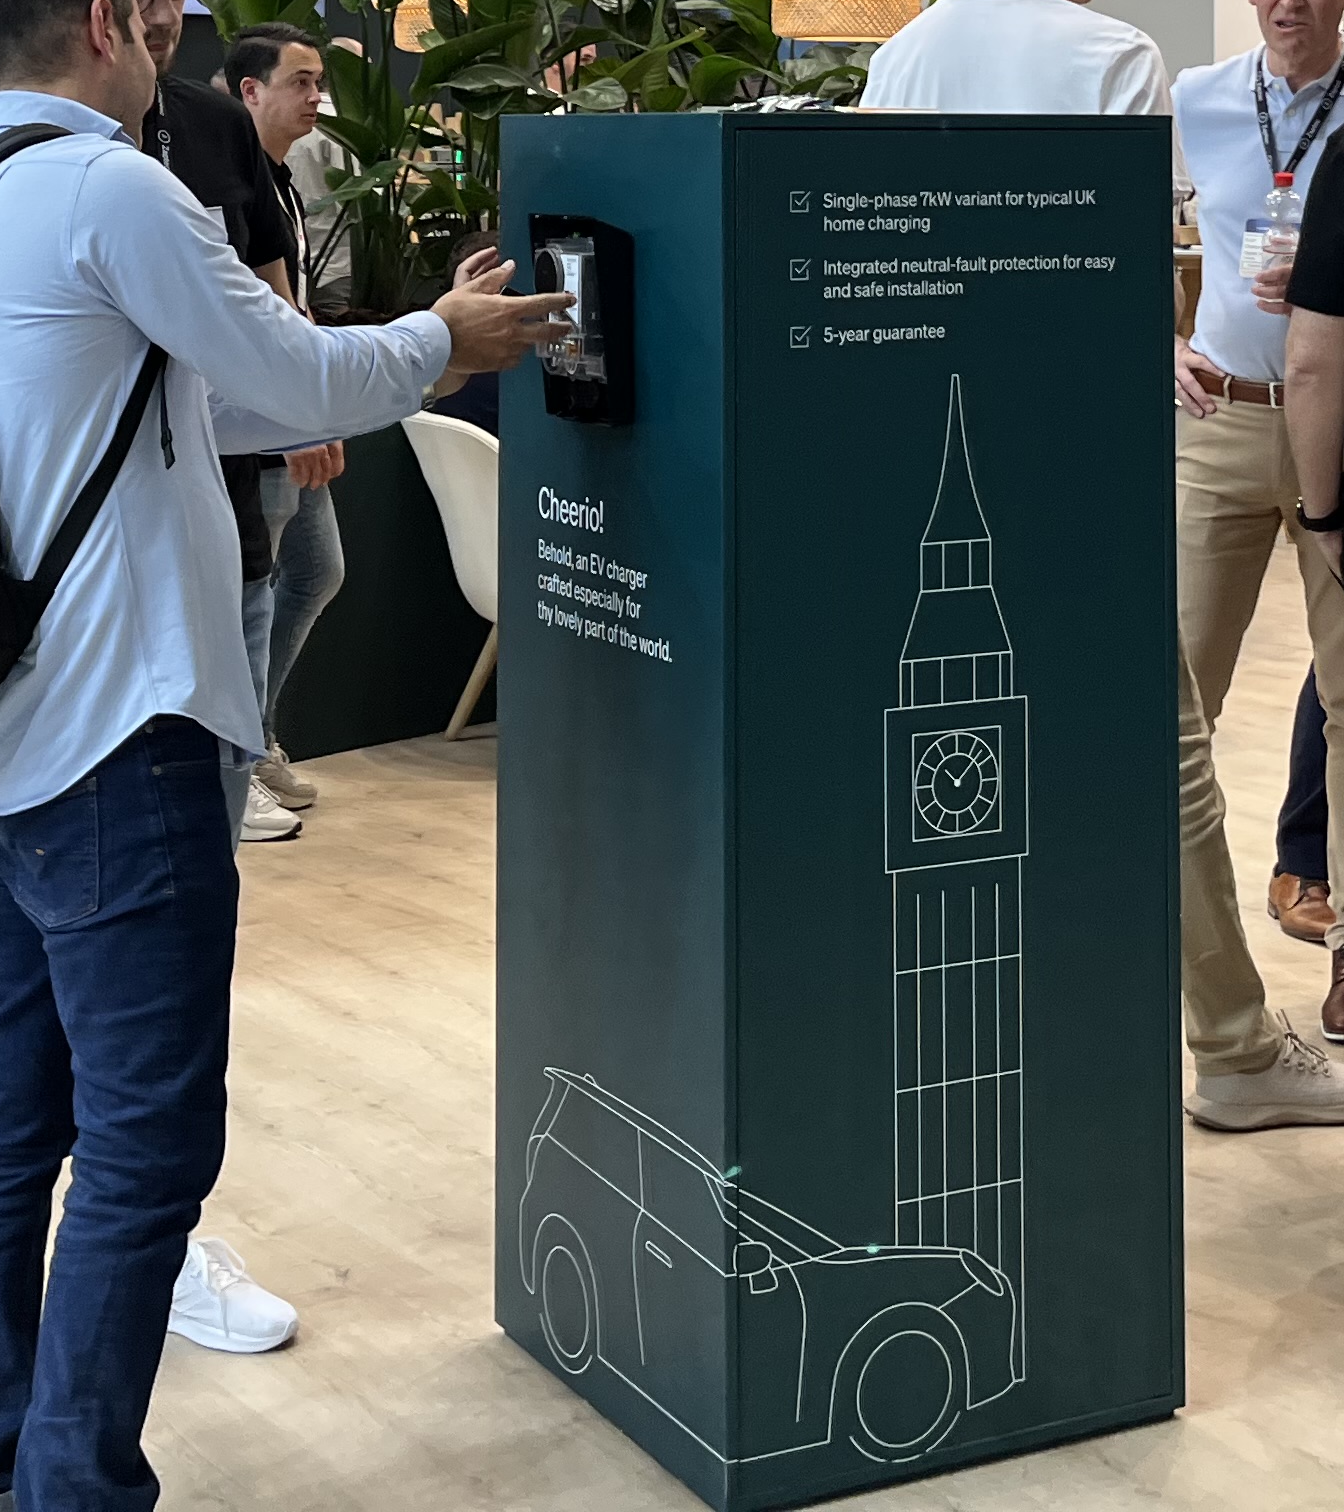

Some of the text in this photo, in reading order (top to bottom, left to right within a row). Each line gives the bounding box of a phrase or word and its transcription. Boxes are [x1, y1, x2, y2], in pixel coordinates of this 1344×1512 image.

[823, 189, 1096, 211] Single-phase 7kW variant for typical UK
[823, 215, 931, 234] home charging
[823, 254, 1116, 278] Integrated neutral-fault protection for easy
[823, 280, 964, 299] and safe installation
[823, 324, 946, 346] 5-year guarantee
[538, 486, 604, 534] Cheerio!
[538, 539, 648, 590] Behold, an EV charger
[537, 573, 641, 619] crafted especially for
[537, 600, 673, 663] thy lovely part of the world.
